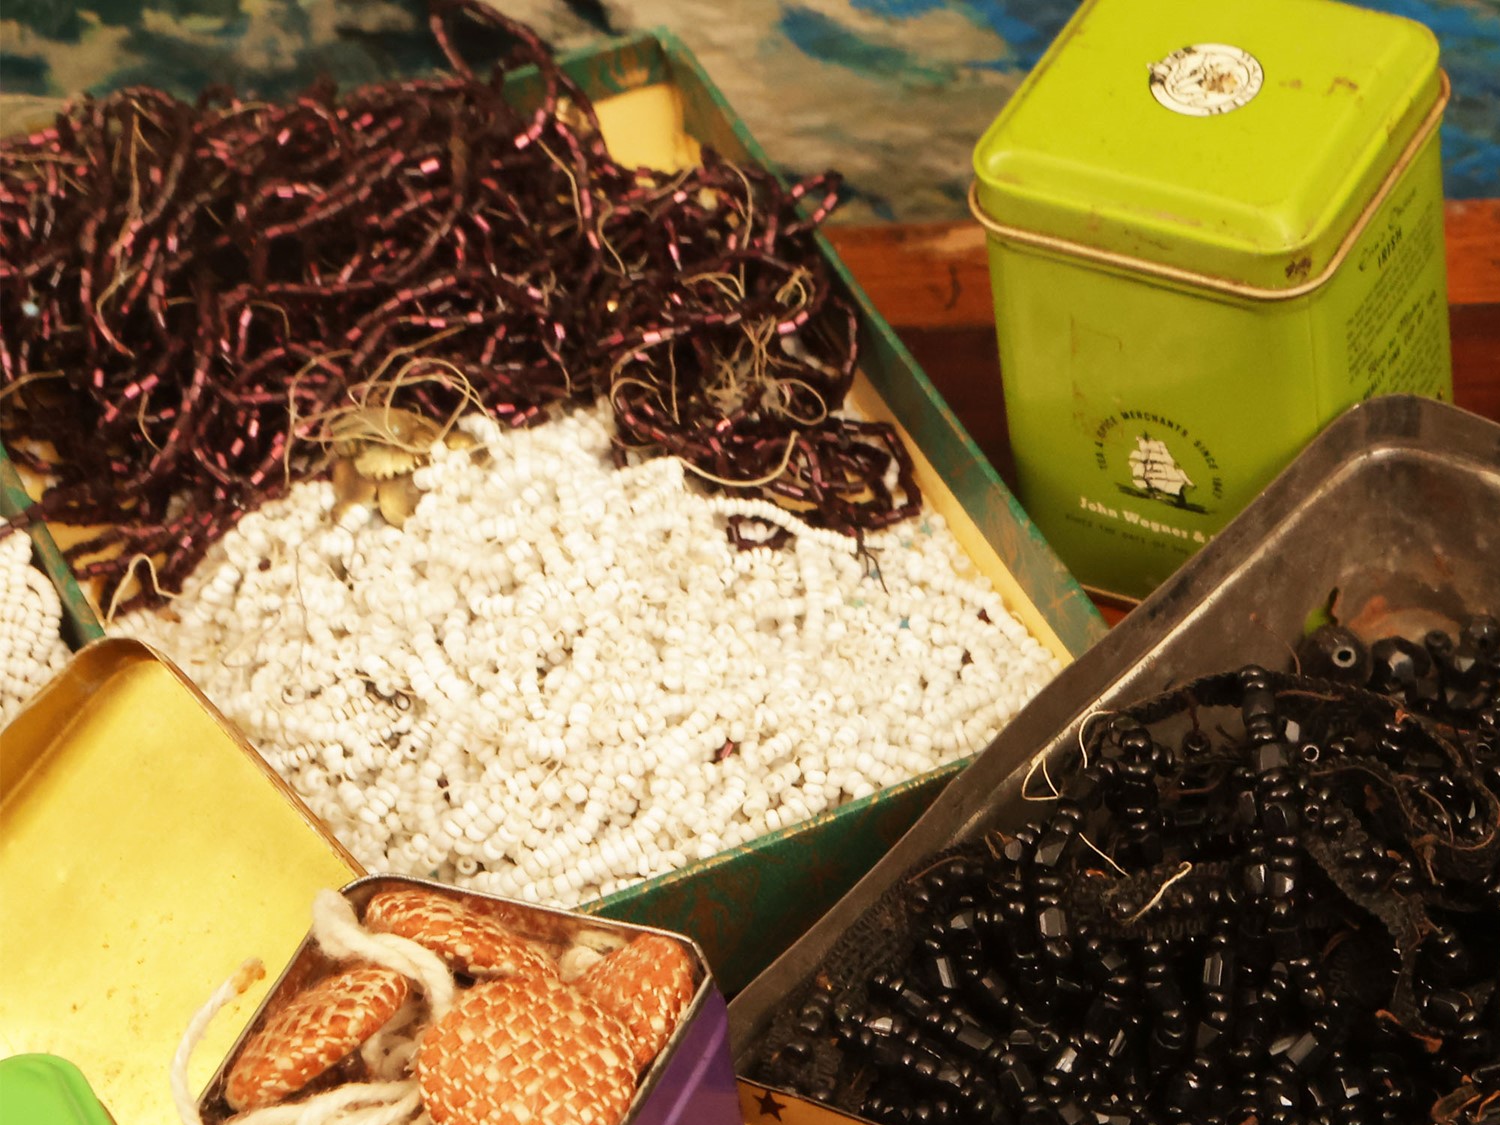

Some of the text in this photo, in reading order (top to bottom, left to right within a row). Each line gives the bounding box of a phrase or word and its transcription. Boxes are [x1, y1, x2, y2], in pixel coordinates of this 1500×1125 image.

[1120, 410, 1189, 438] MERCHANTS
[1193, 439, 1219, 471] SINCE
[1079, 495, 1119, 519] John
[1122, 510, 1189, 540] Wagner
[1193, 530, 1206, 543] &
